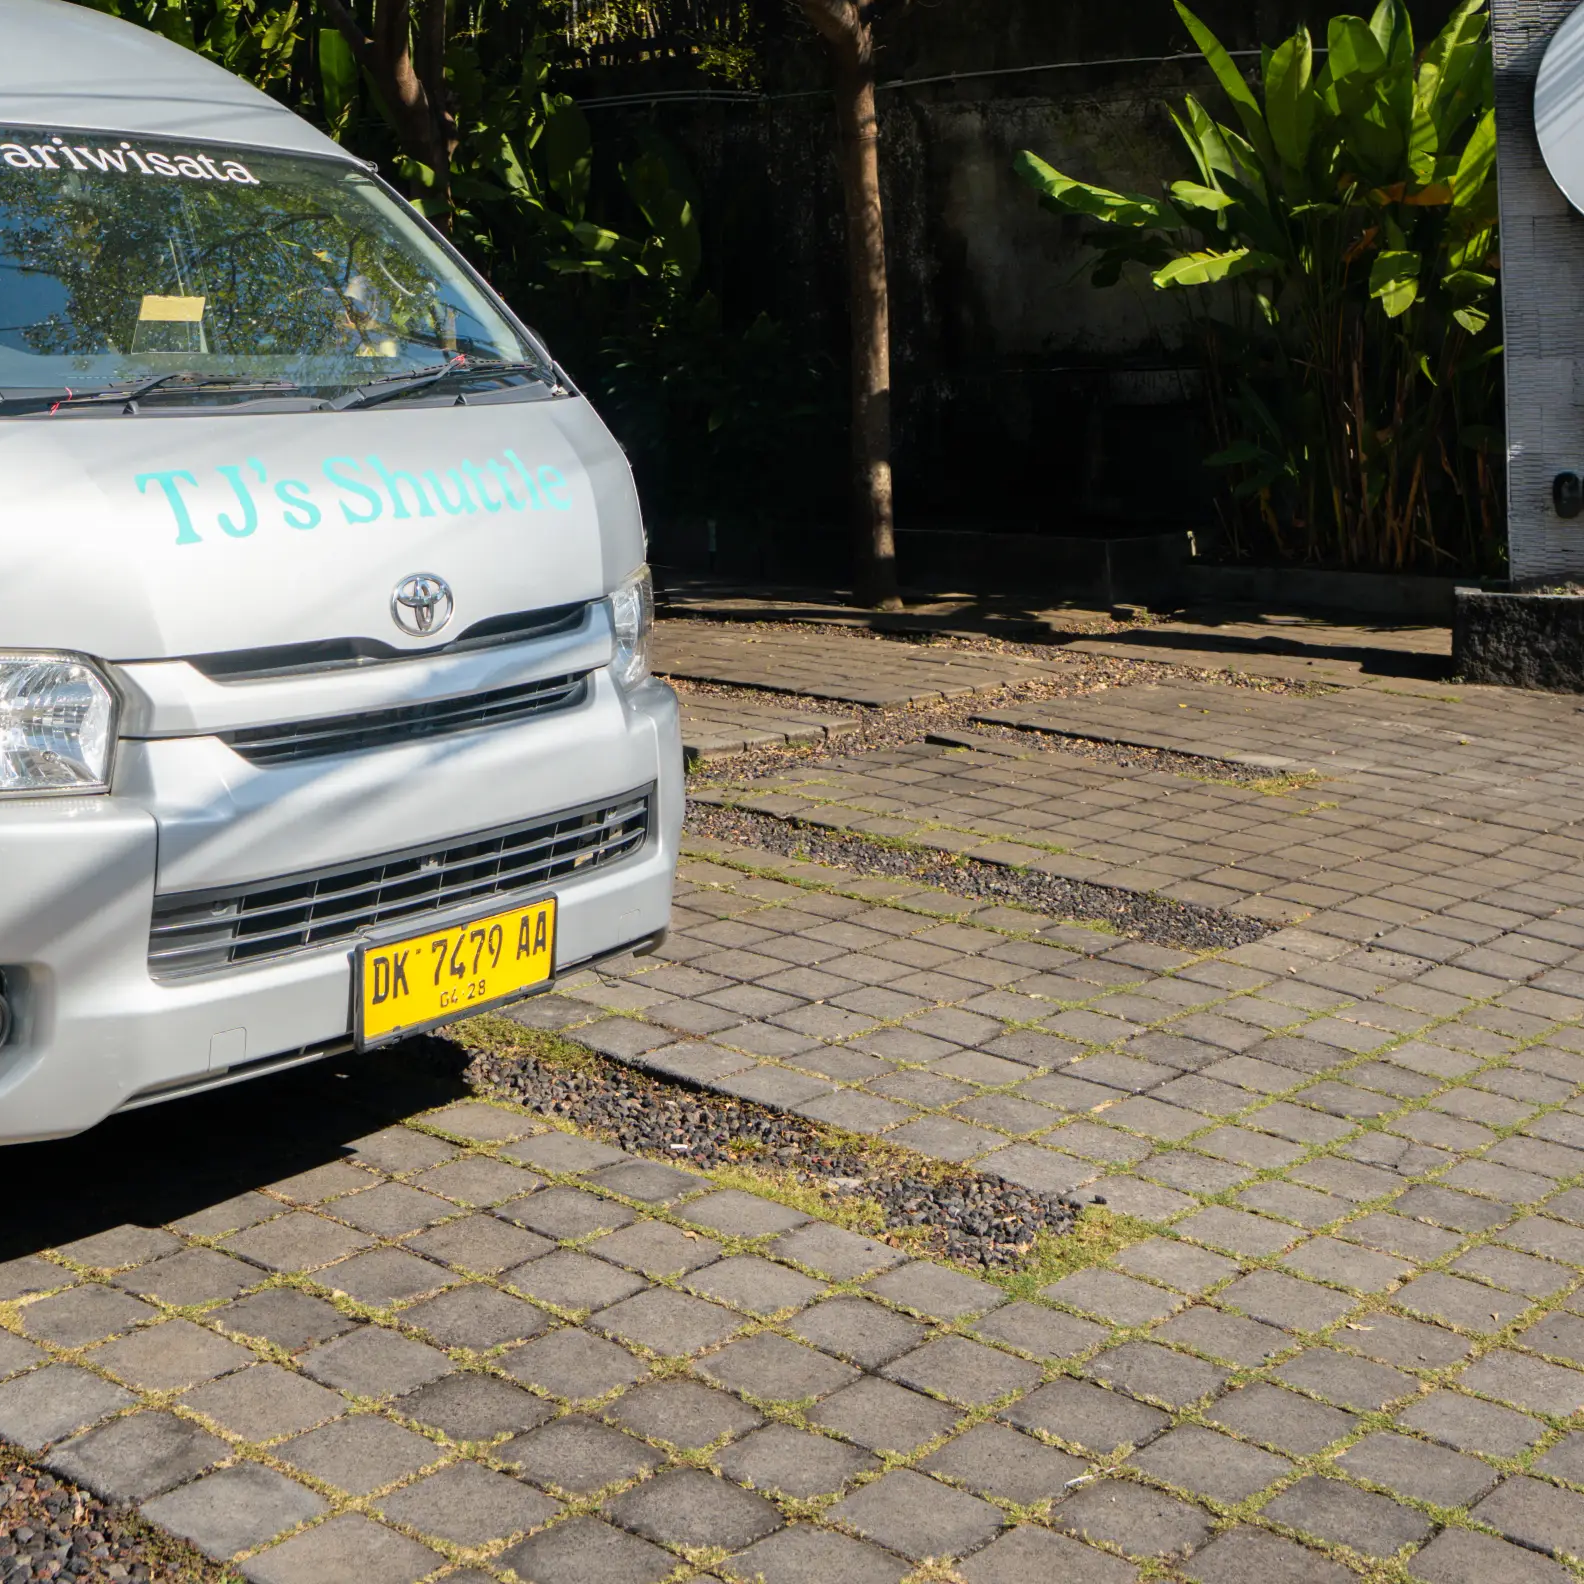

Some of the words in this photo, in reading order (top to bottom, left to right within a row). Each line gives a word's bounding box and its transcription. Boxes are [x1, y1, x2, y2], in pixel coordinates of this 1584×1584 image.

[134, 457, 322, 546] TJ's
[321, 449, 573, 526] Shuttle
[372, 949, 410, 1006] DK
[431, 924, 503, 986] 7479
[516, 911, 547, 961] AA
